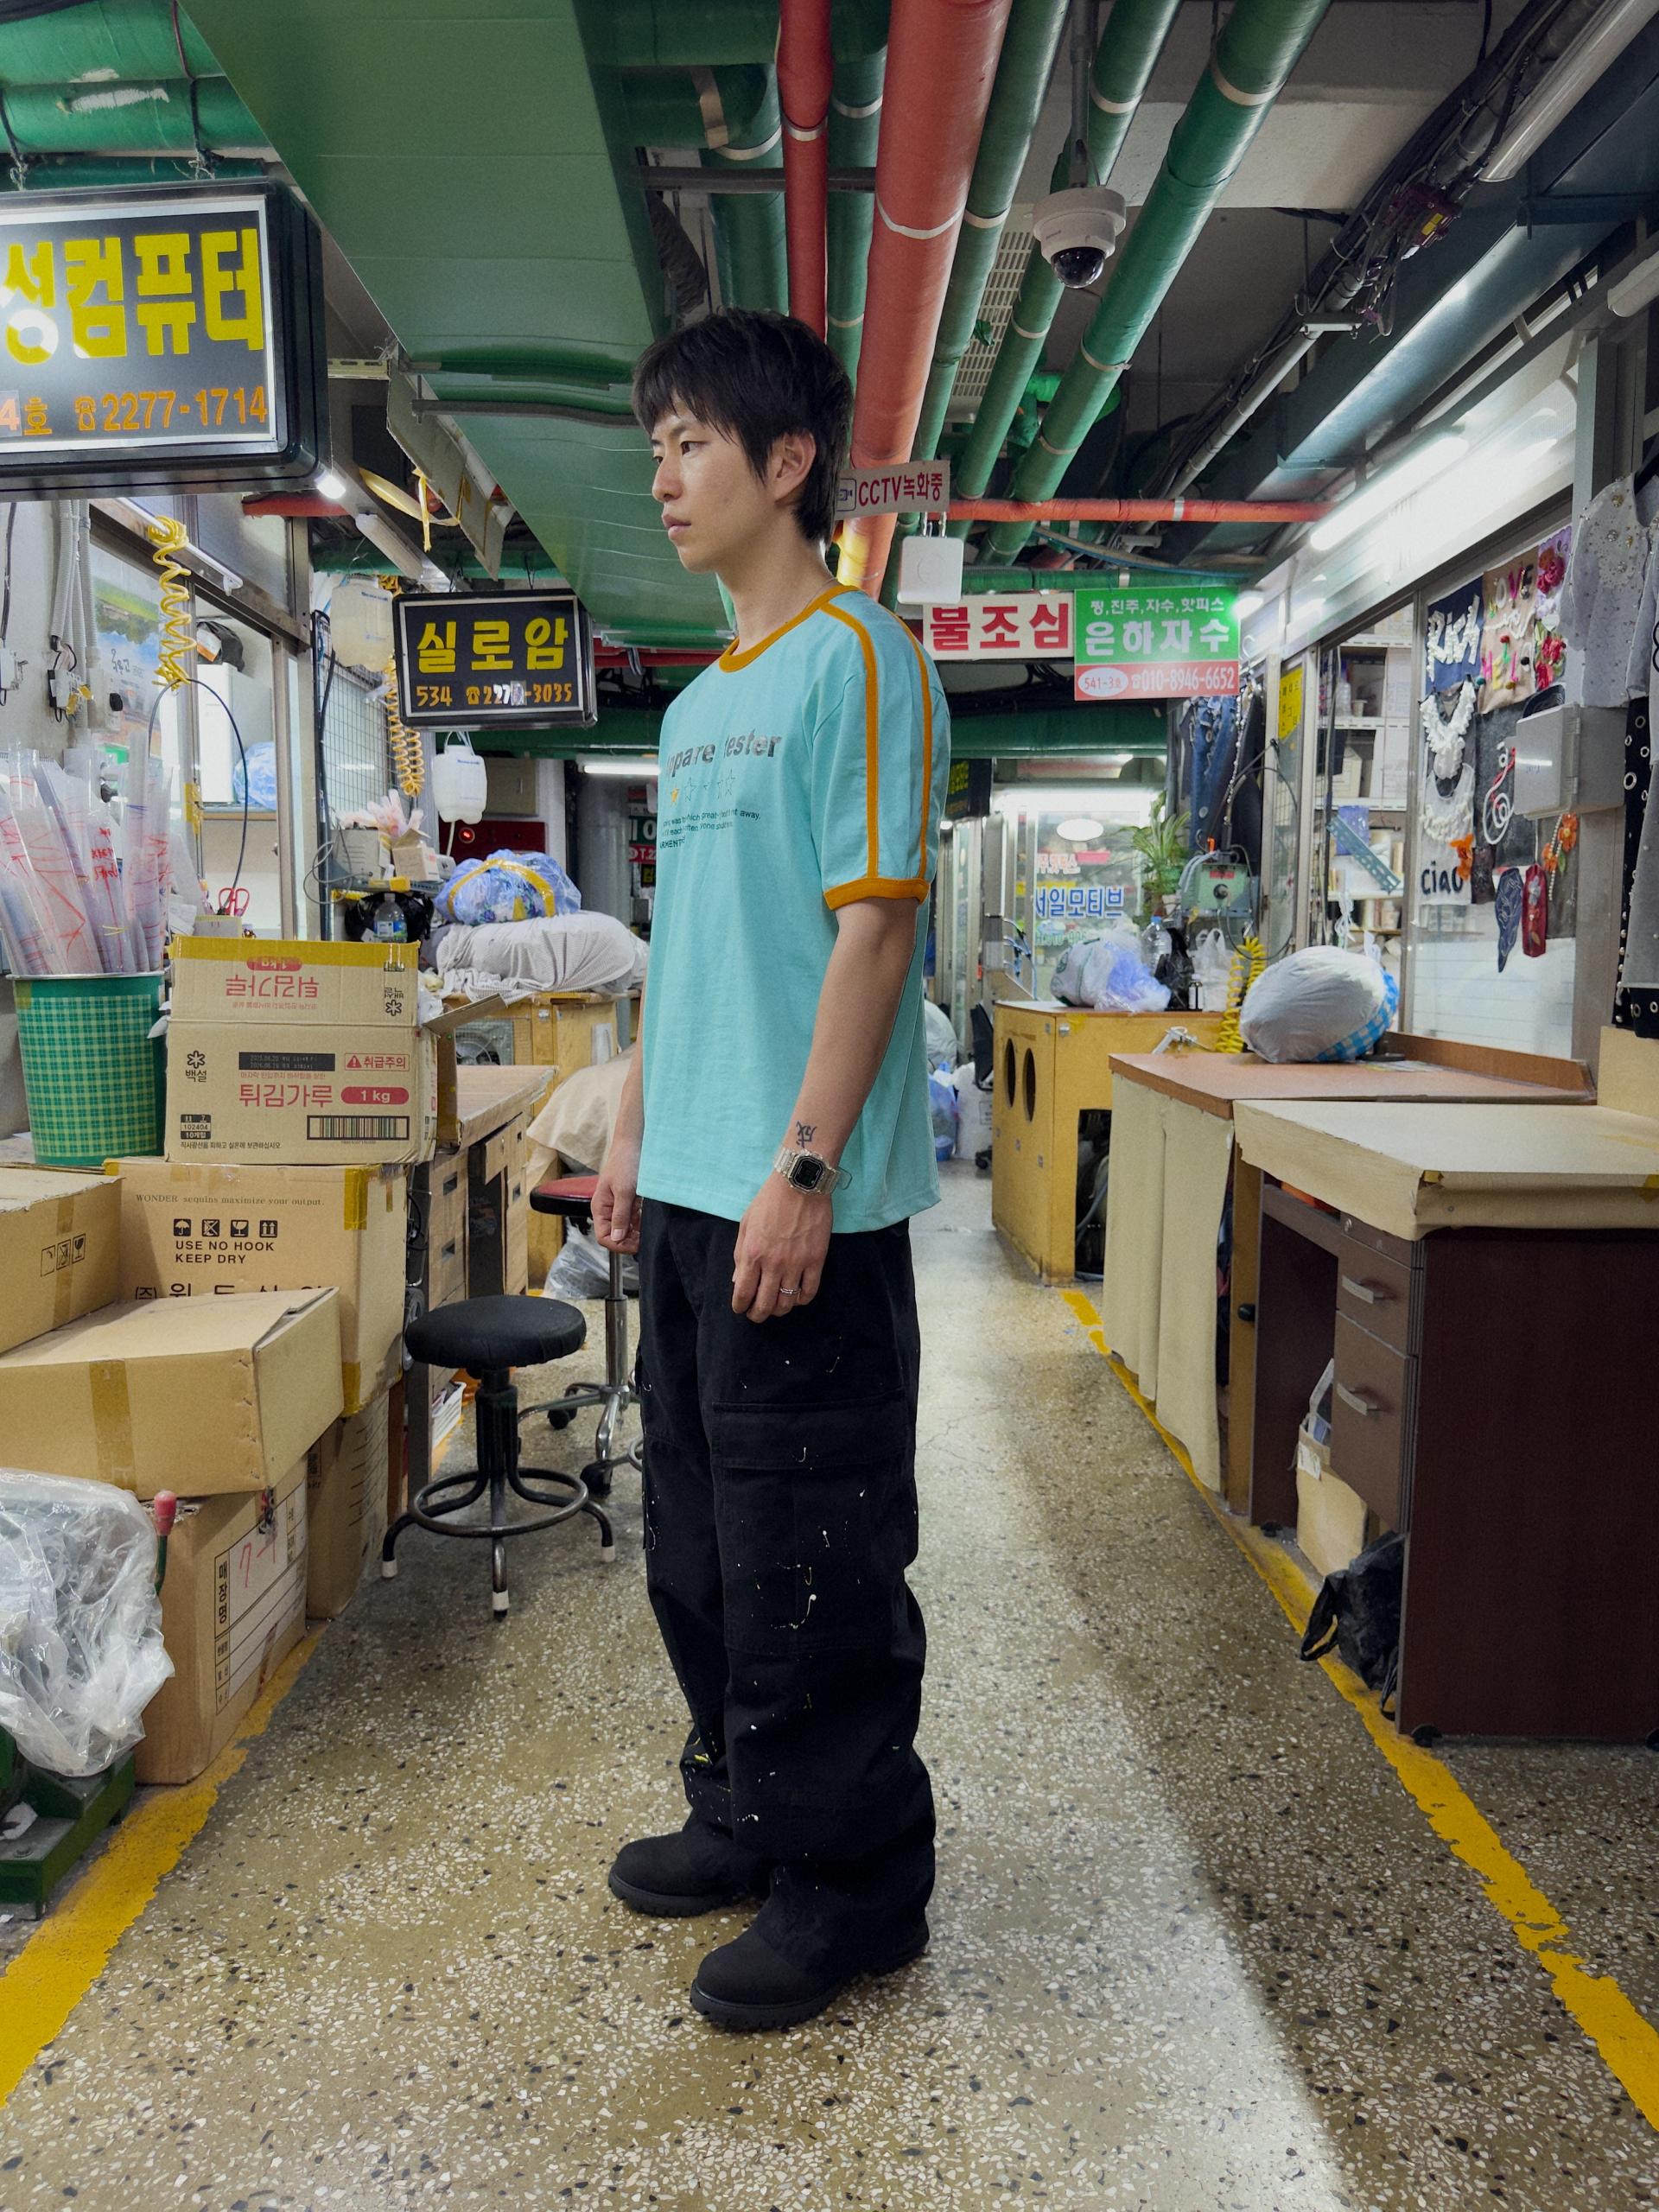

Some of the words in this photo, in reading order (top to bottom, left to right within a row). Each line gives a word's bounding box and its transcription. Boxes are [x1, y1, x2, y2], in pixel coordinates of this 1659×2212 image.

[103, 386, 268, 431] 2277-1714
[930, 603, 1069, 652] 불조심
[1085, 619, 1230, 657] 은하자수
[416, 617, 569, 673] 실로암
[1141, 666, 1235, 692] 010-8946-6652
[416, 685, 453, 707] 534
[226, 974, 320, 998] 튀김가루
[363, 1056, 406, 1070] 취급주의
[185, 1070, 207, 1082] 백설
[239, 1084, 333, 1108] 튀김가루
[360, 1090, 367, 1101] 1
[372, 1089, 391, 1103] kg
[136, 1194, 178, 1203] WONDER
[183, 1196, 218, 1205] sequins
[221, 1197, 266, 1205] maximize
[175, 1241, 203, 1250] USE
[208, 1241, 228, 1251] NO
[234, 1242, 274, 1251] HOOK
[175, 1254, 212, 1263] KEEP
[218, 1255, 246, 1264] DRY
